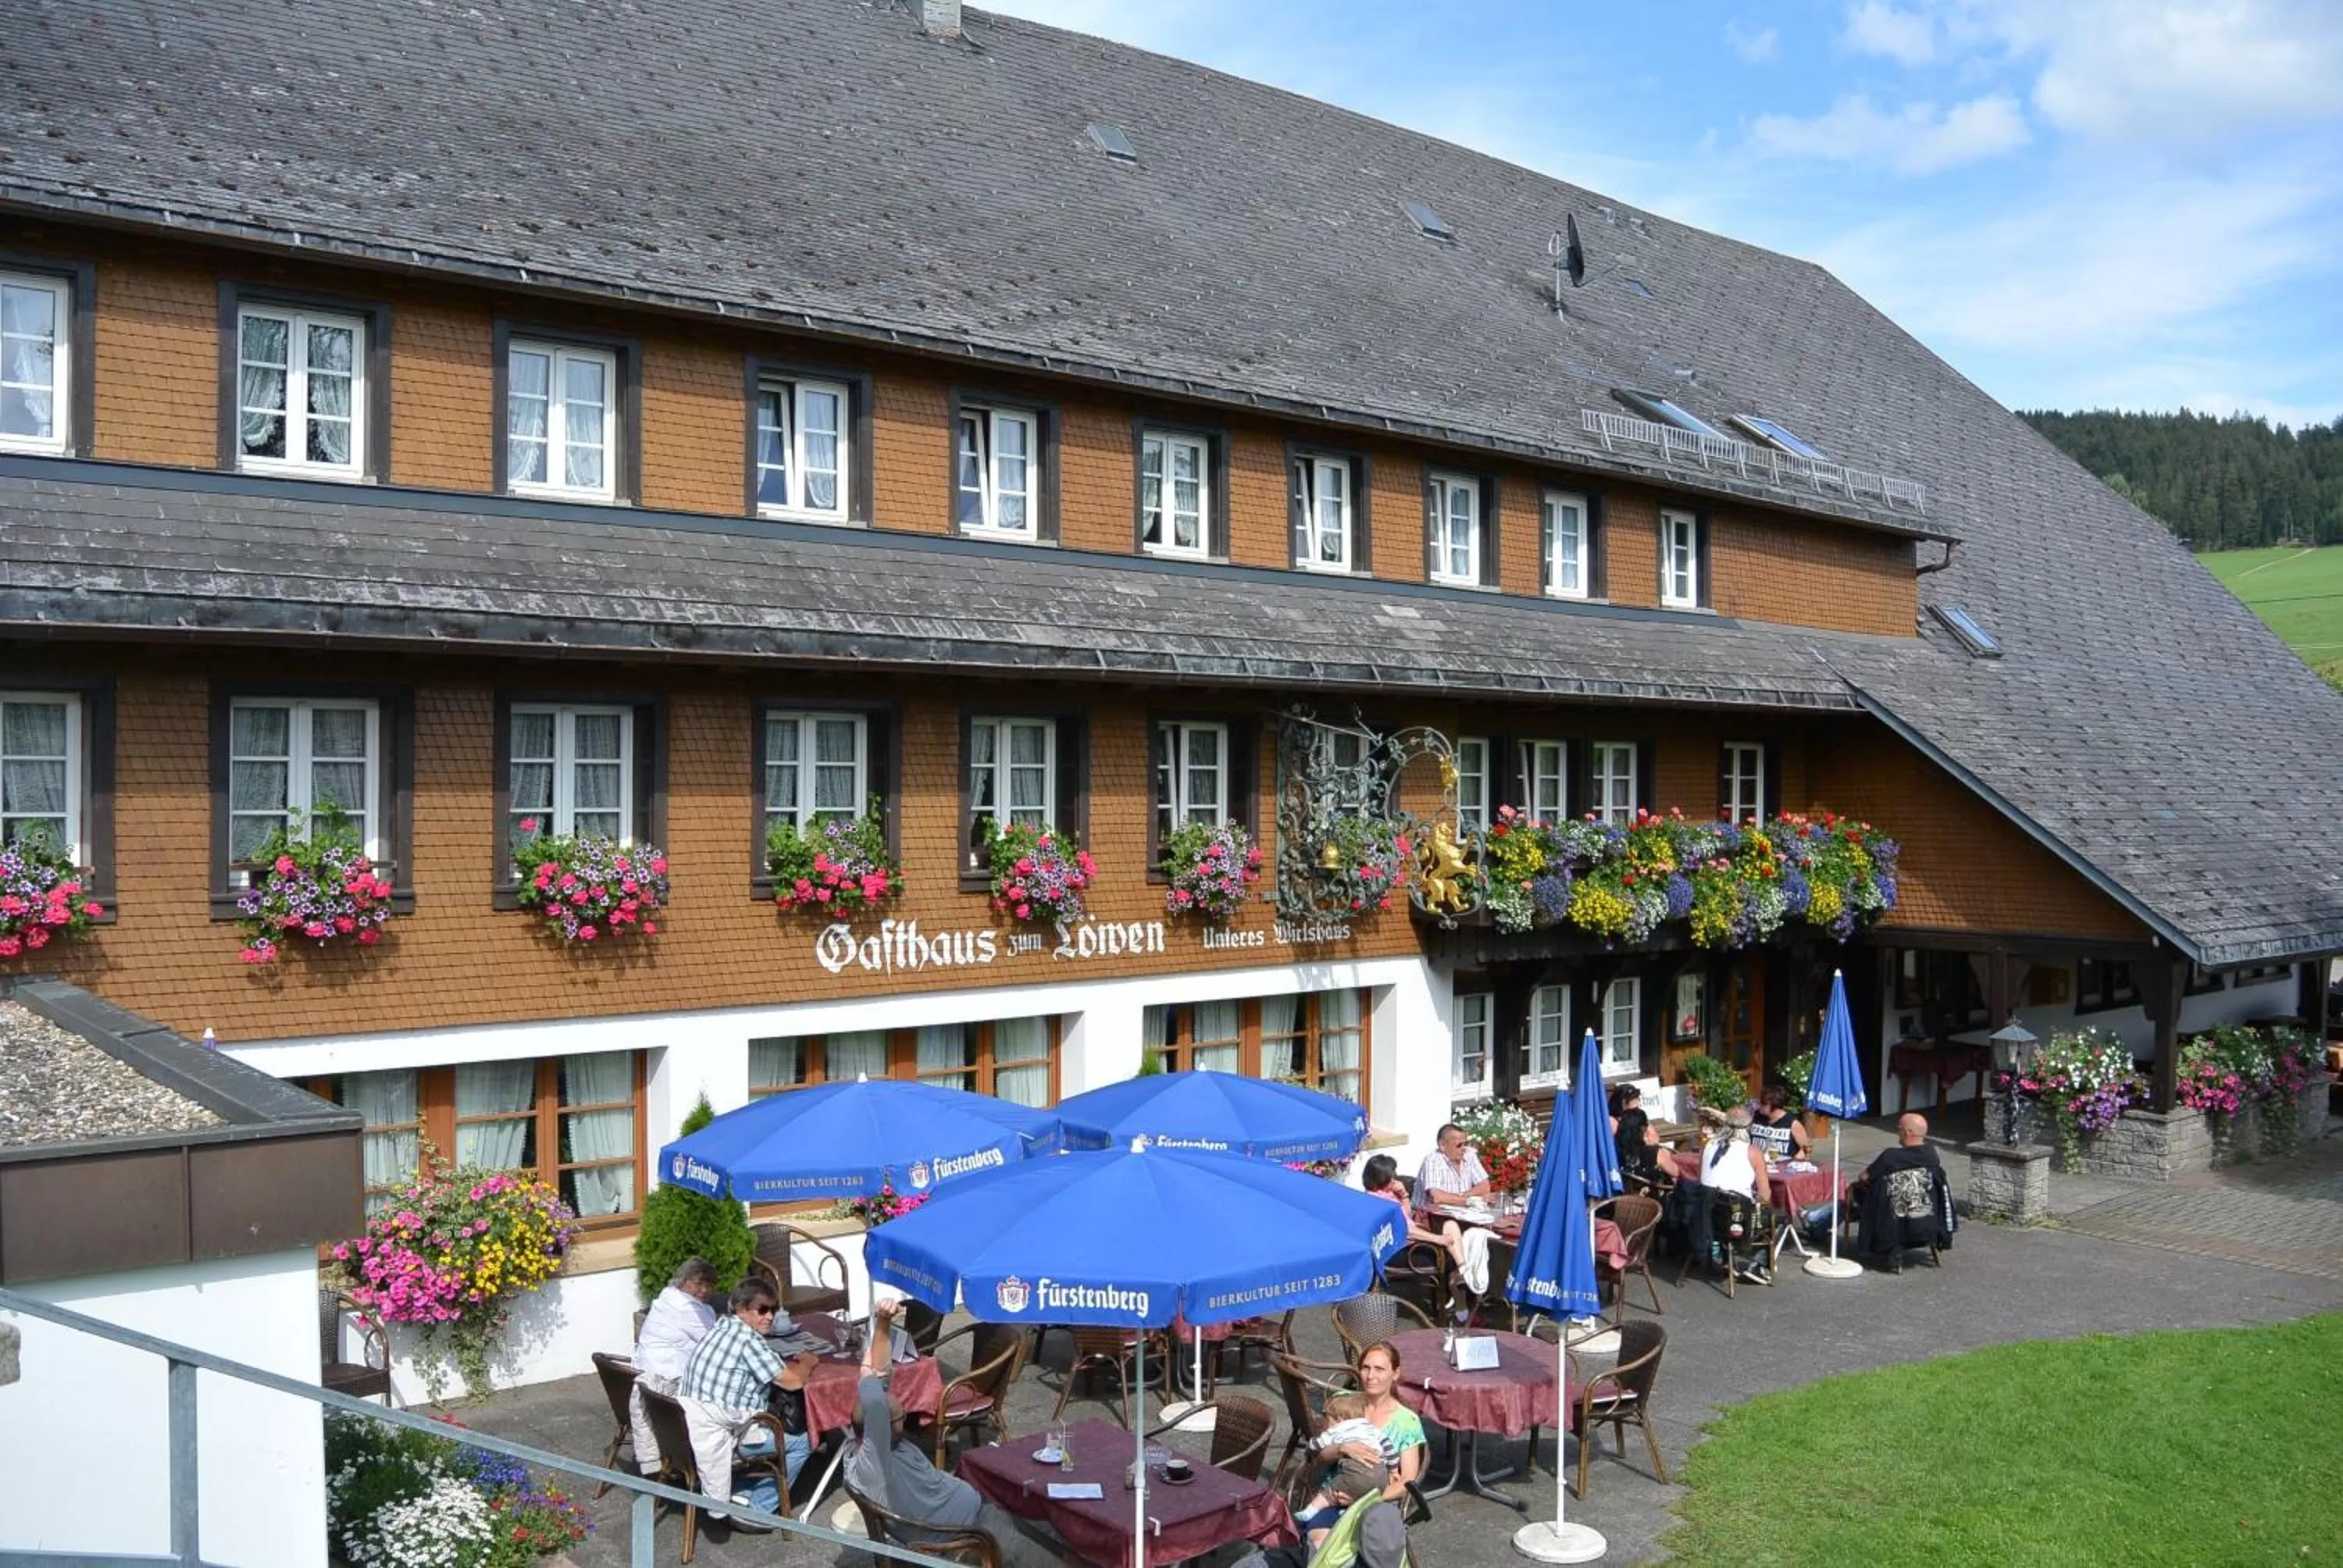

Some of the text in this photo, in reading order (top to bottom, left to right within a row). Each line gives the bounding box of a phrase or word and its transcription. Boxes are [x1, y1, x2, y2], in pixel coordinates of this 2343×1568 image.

[1007, 932, 1041, 957] zum
[1203, 926, 1264, 950] Unteres
[933, 1147, 1004, 1181] Fürstenberg
[754, 1177, 816, 1191] BIERKULTUR
[818, 1177, 840, 1187] SEIT
[1037, 1278, 1149, 1318] Fürstenberg
[1209, 1274, 1341, 1309] BIERKULTUR SEIT 1283
